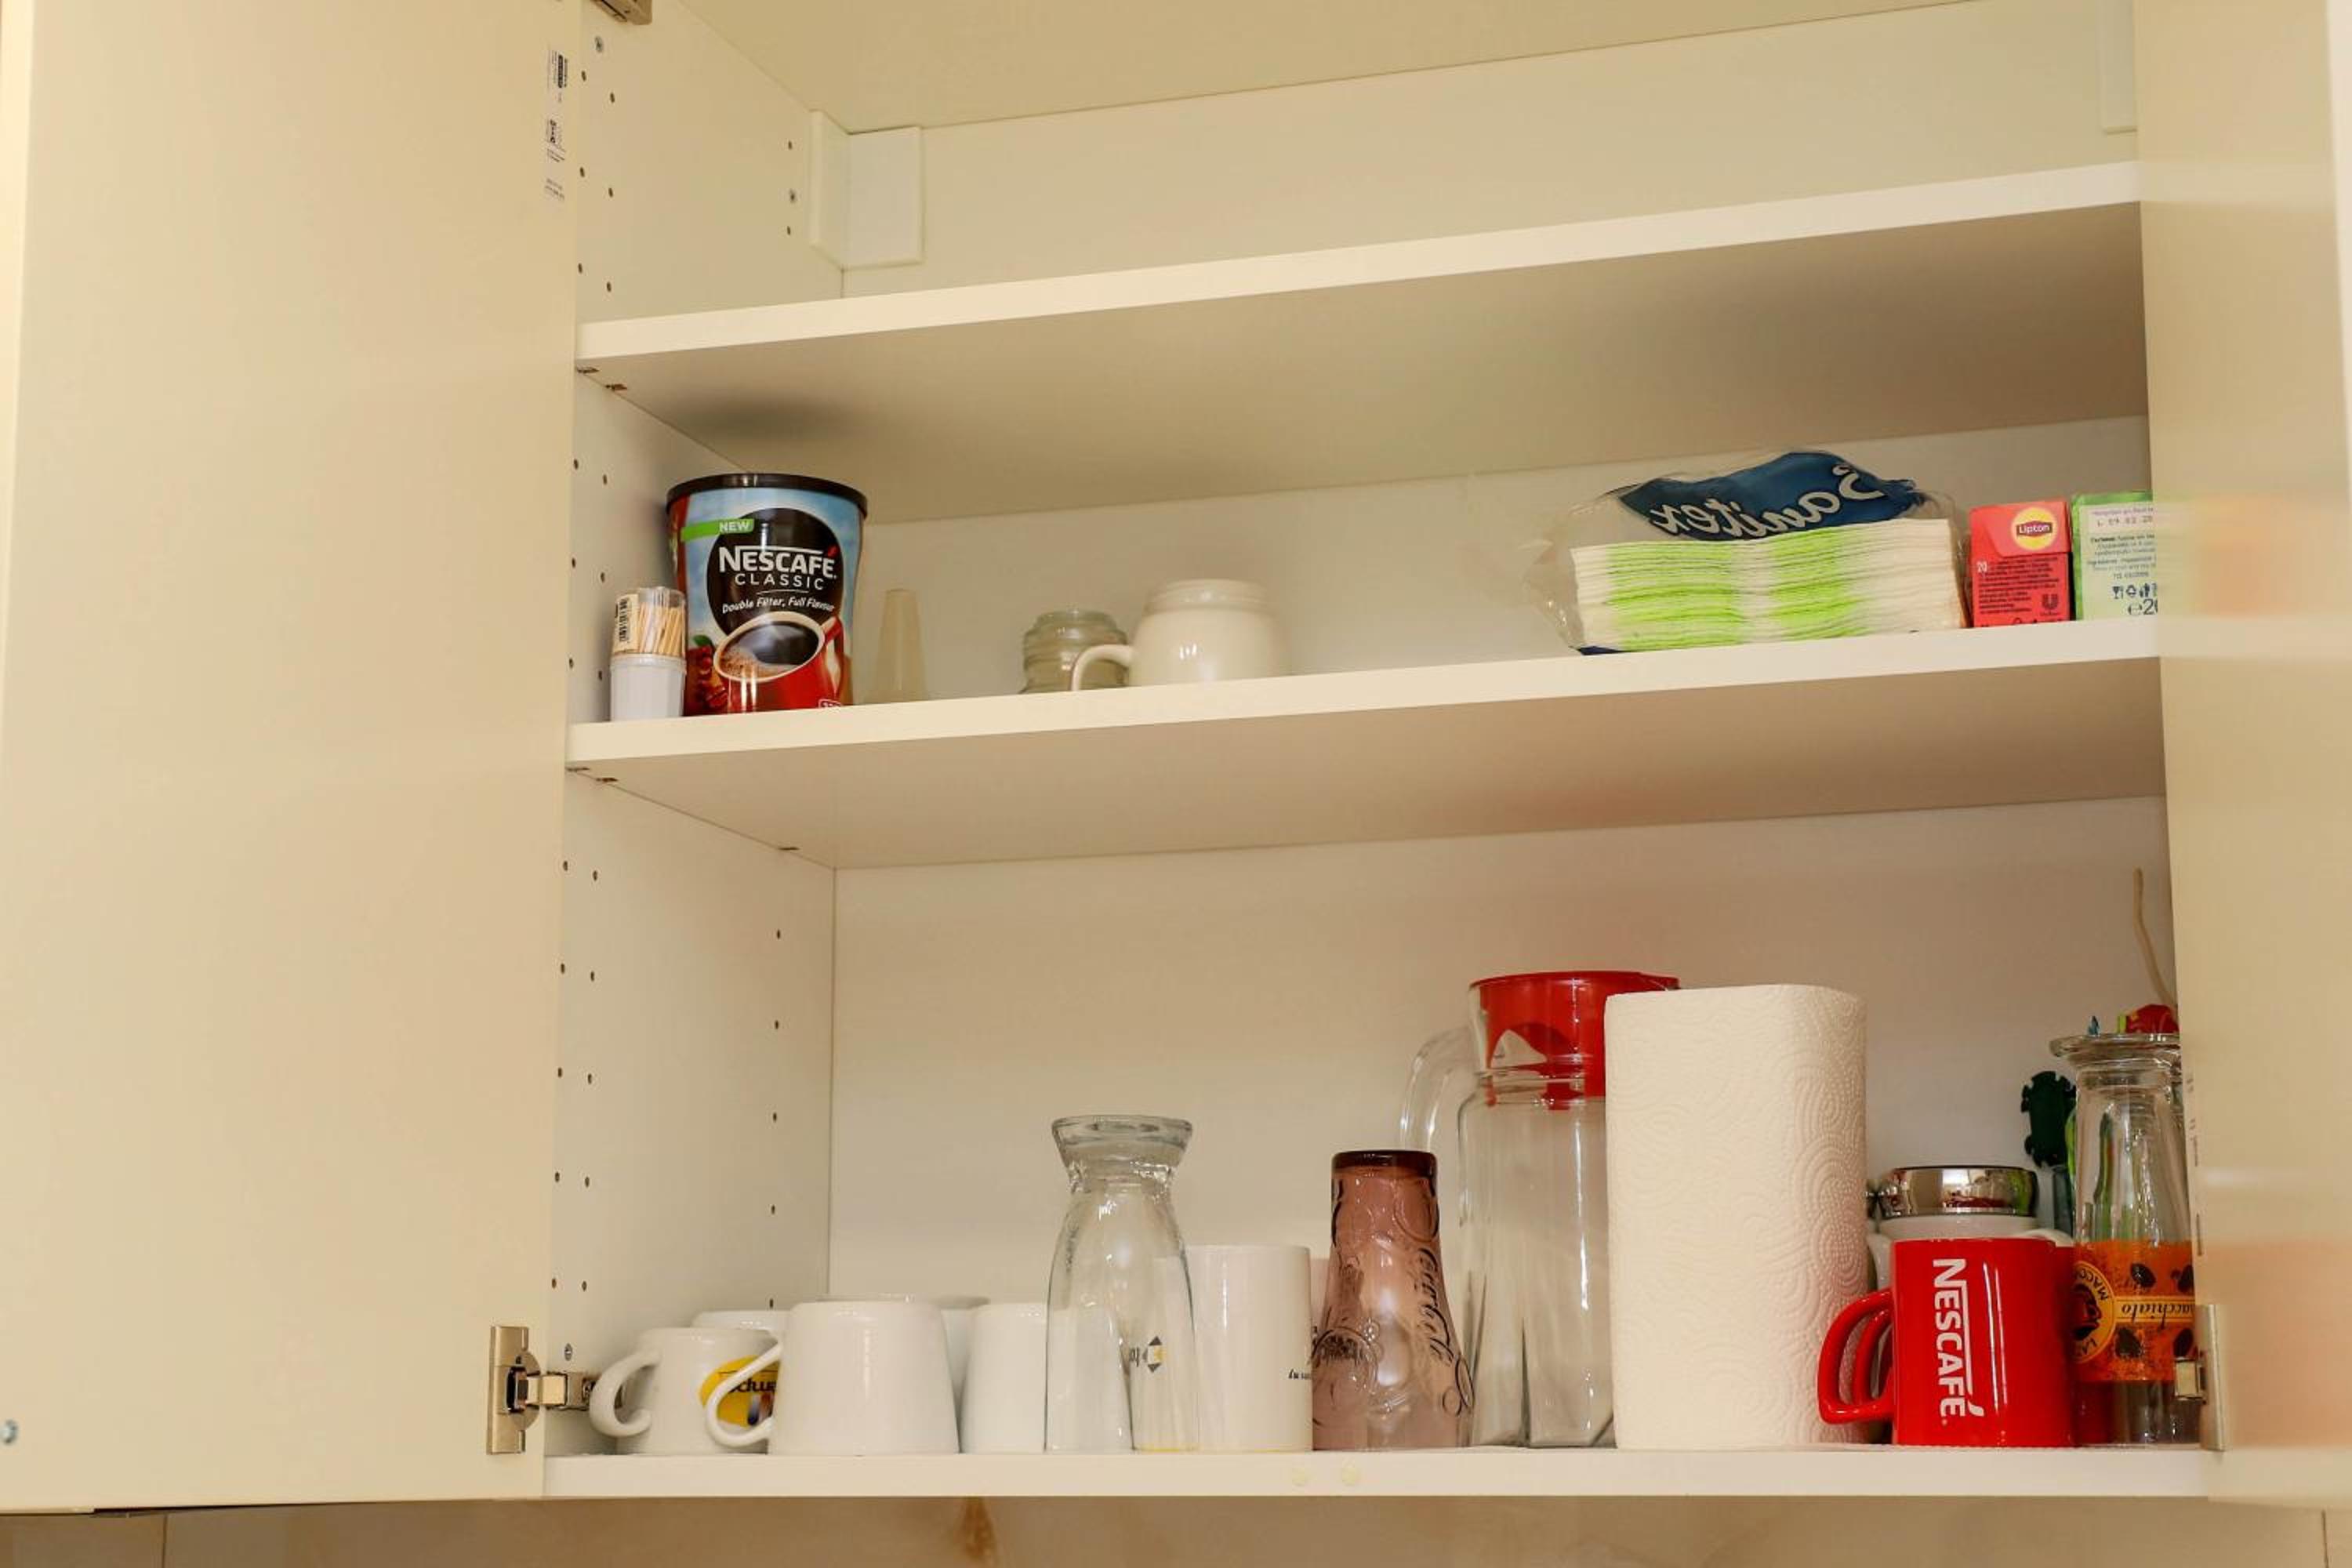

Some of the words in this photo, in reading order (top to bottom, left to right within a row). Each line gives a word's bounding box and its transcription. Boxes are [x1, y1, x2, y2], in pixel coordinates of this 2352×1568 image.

[719, 521, 750, 532] NEW
[2018, 523, 2051, 535] Lipton
[735, 573, 825, 590] CLASSIC
[721, 597, 755, 614] Double
[788, 597, 806, 607] Full
[1932, 1257, 1985, 1421] NESCAFÉ
